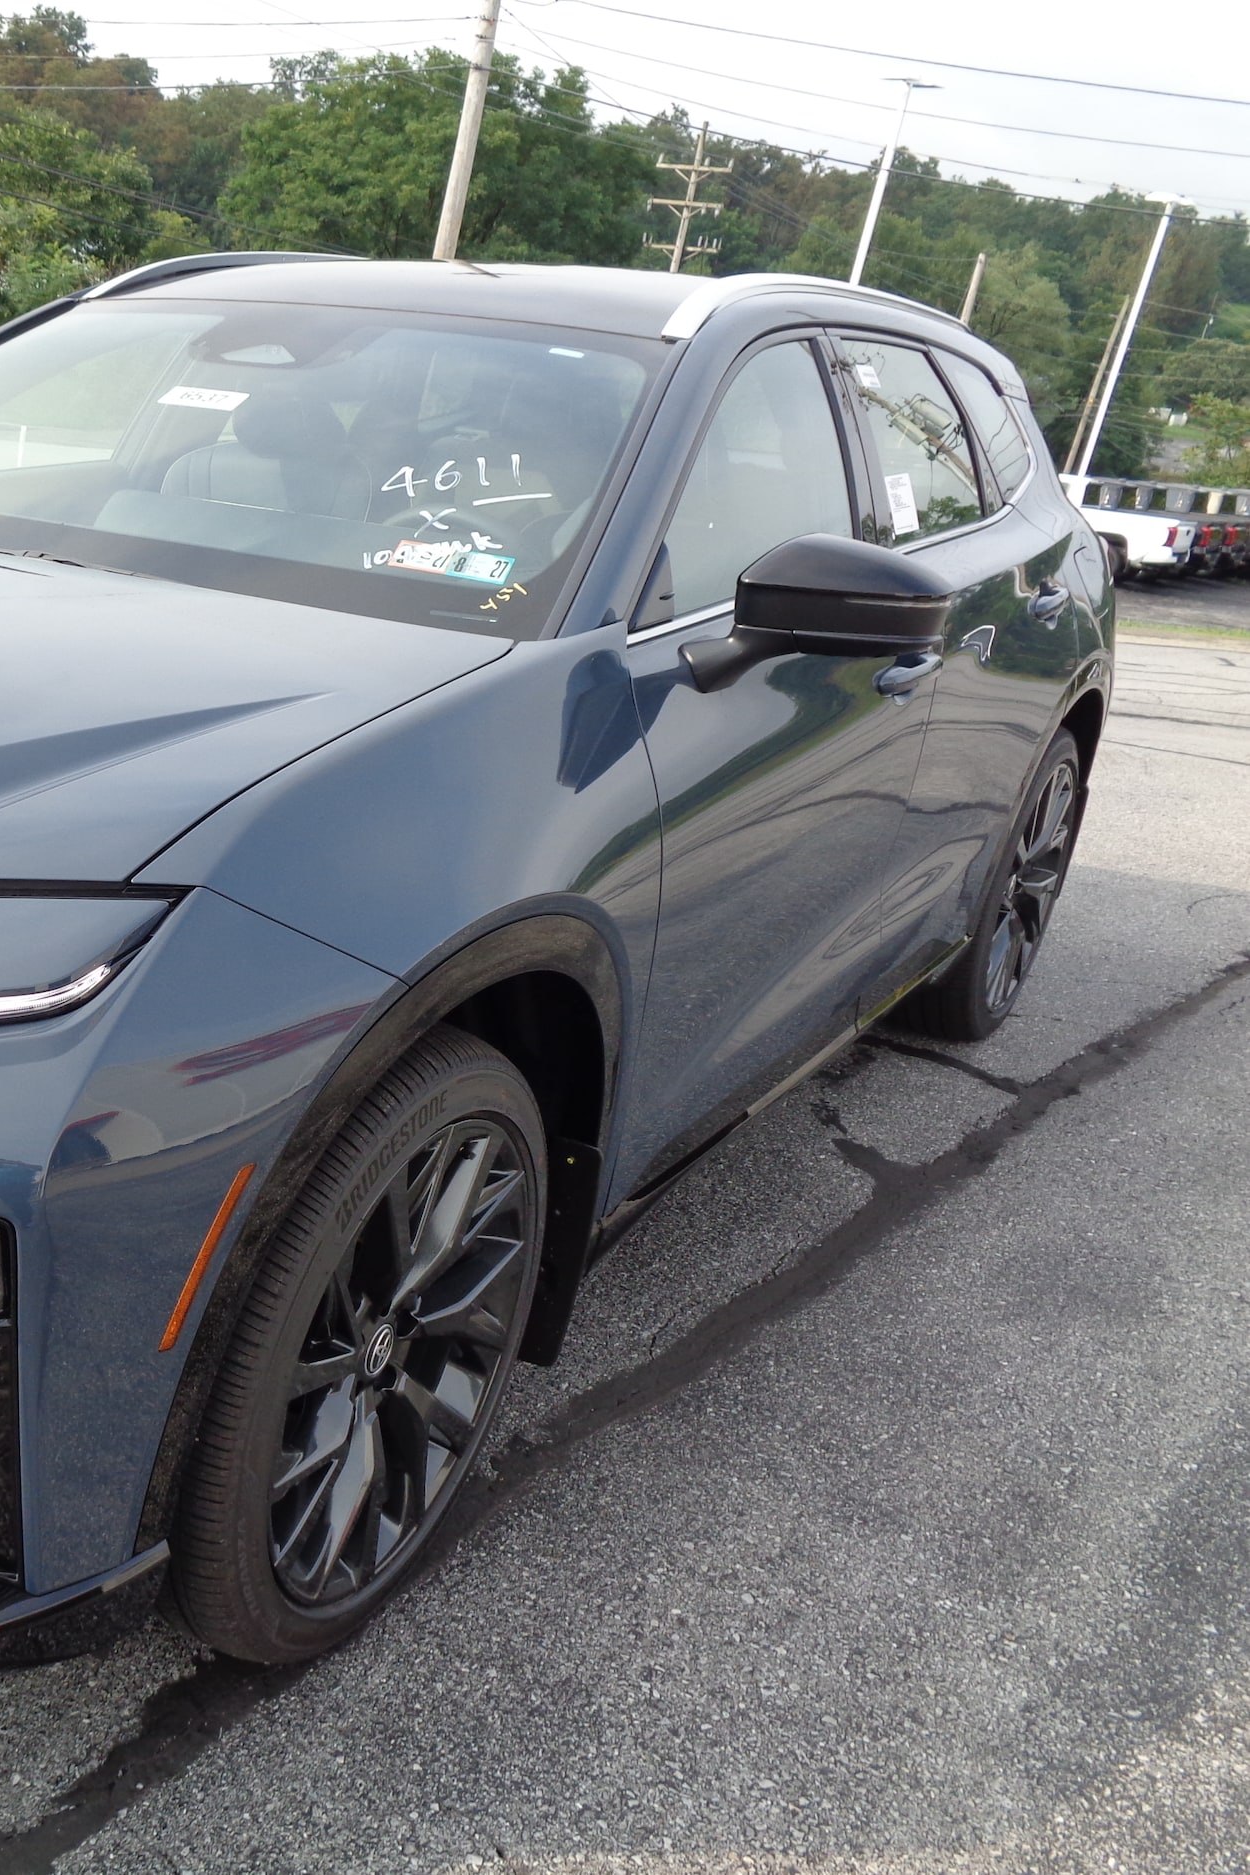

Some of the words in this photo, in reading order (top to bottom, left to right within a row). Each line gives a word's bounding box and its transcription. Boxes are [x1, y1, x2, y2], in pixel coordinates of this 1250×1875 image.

[381, 453, 521, 497] 4611
[489, 559, 510, 579] 27
[335, 1089, 449, 1234] BRIDGESTONE
